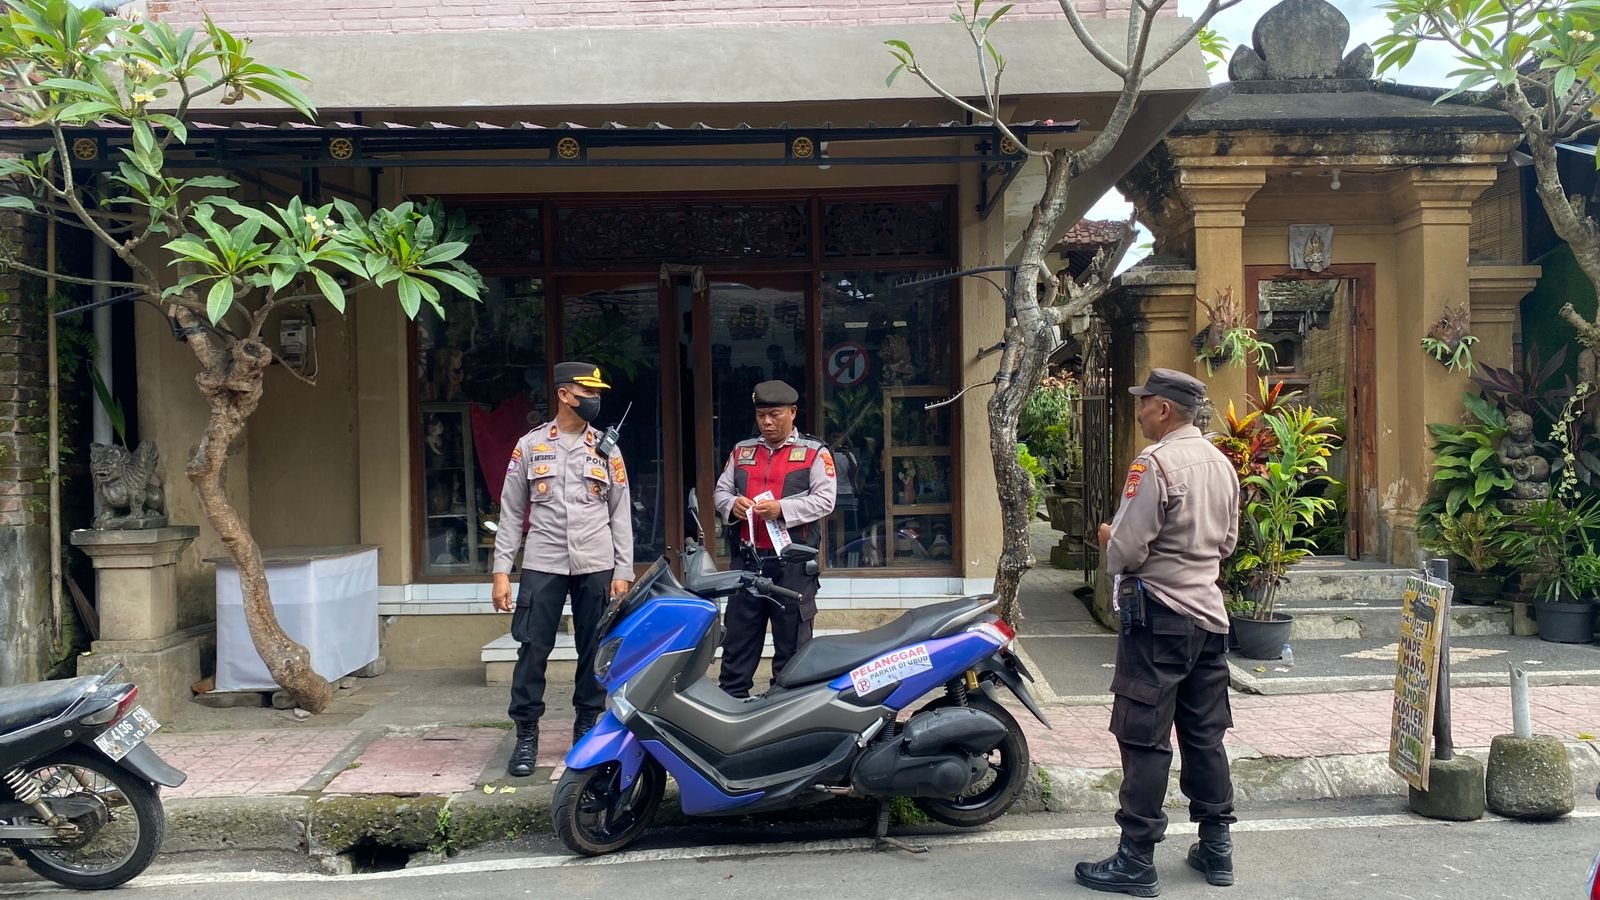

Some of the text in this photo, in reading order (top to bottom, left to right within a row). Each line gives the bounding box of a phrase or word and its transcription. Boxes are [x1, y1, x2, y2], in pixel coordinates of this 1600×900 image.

[1401, 635, 1422, 656] MADE
[851, 646, 926, 680] PELANGGAR
[869, 666, 897, 680] PARKIR
[908, 655, 928, 666] UBUD
[1402, 684, 1418, 704] AND
[1393, 695, 1424, 728] SCOOTER
[95, 736, 111, 752] DK
[110, 720, 134, 741] 4136
